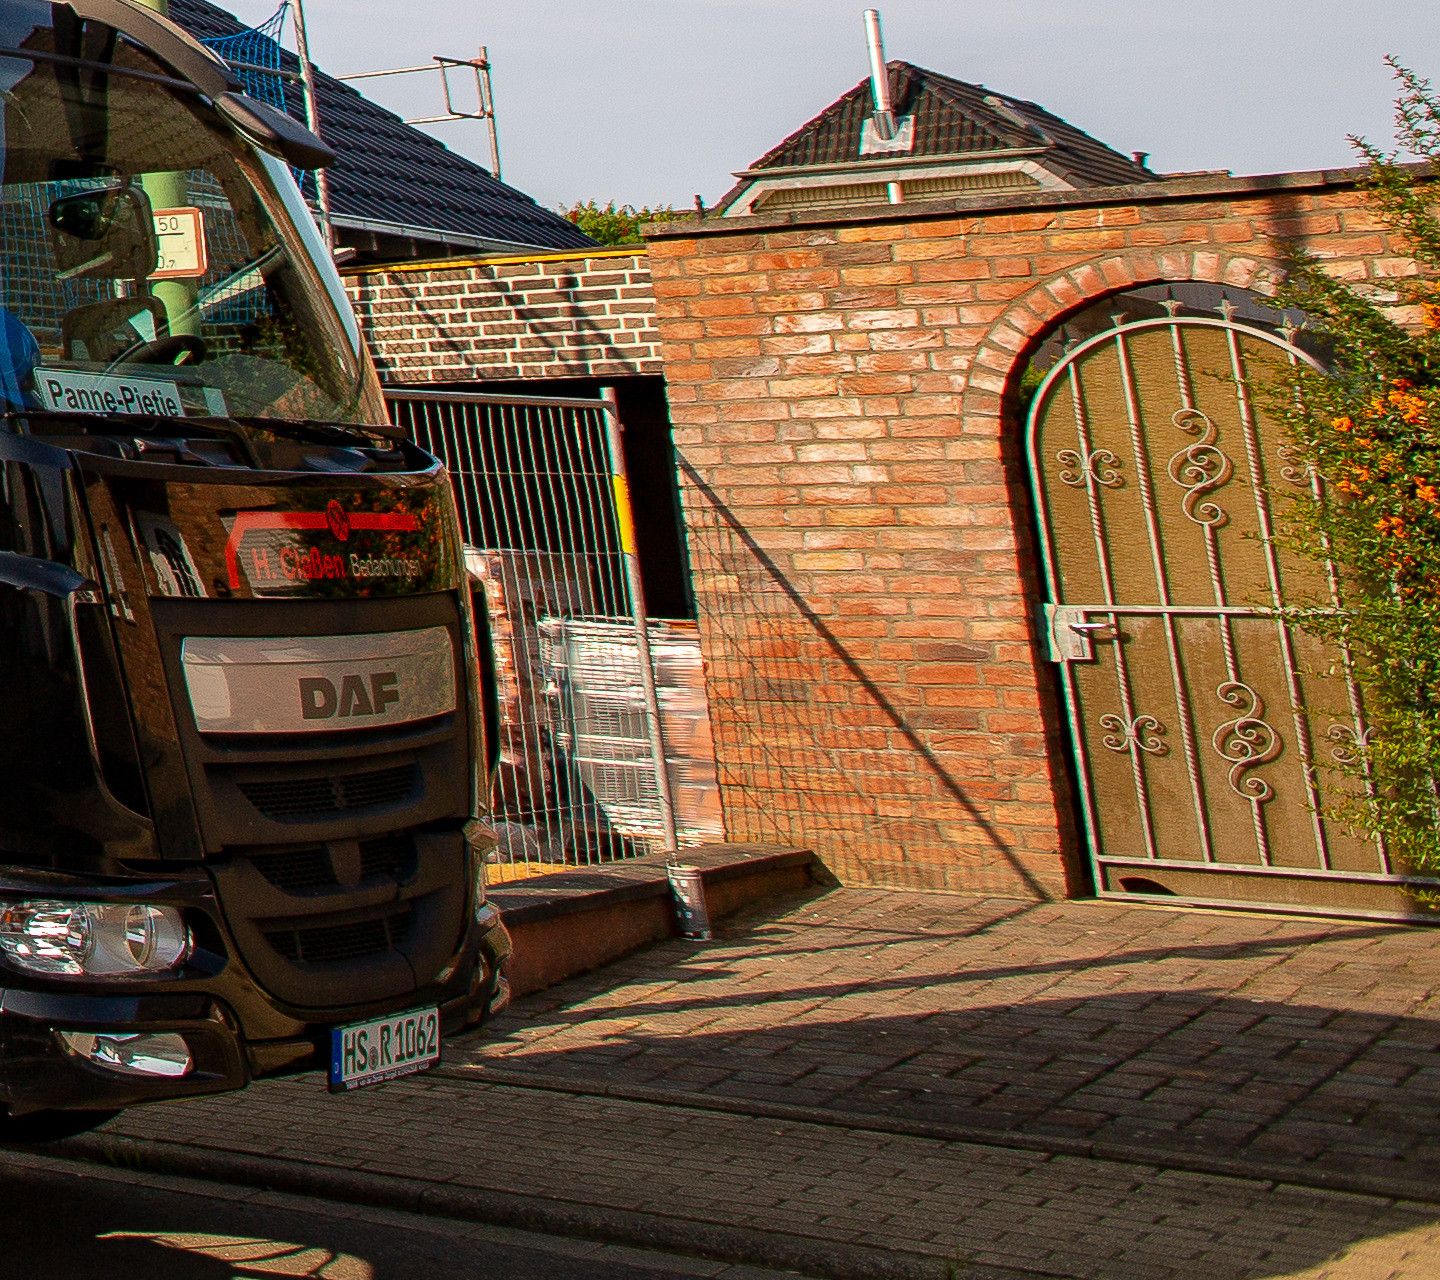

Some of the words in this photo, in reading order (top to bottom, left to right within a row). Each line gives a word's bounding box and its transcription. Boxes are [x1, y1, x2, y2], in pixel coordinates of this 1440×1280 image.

[251, 547, 277, 581] H.
[280, 547, 347, 580] Claßen
[350, 553, 424, 582] Bedachungen
[298, 671, 400, 719] DAF
[344, 1030, 368, 1075] HS
